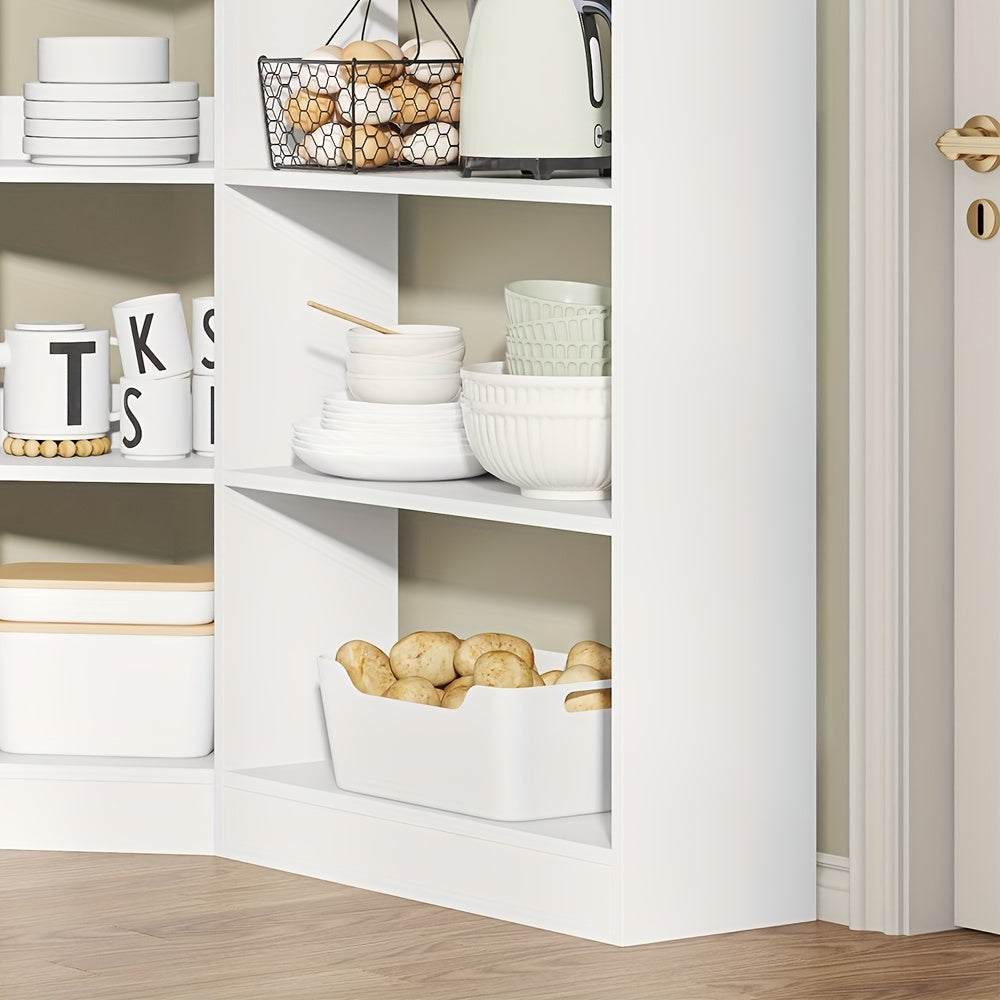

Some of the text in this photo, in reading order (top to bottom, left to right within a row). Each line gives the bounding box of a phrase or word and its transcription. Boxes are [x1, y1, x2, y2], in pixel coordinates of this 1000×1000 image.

[128, 312, 167, 374] K
[49, 340, 97, 426] T
[122, 387, 142, 449] S
